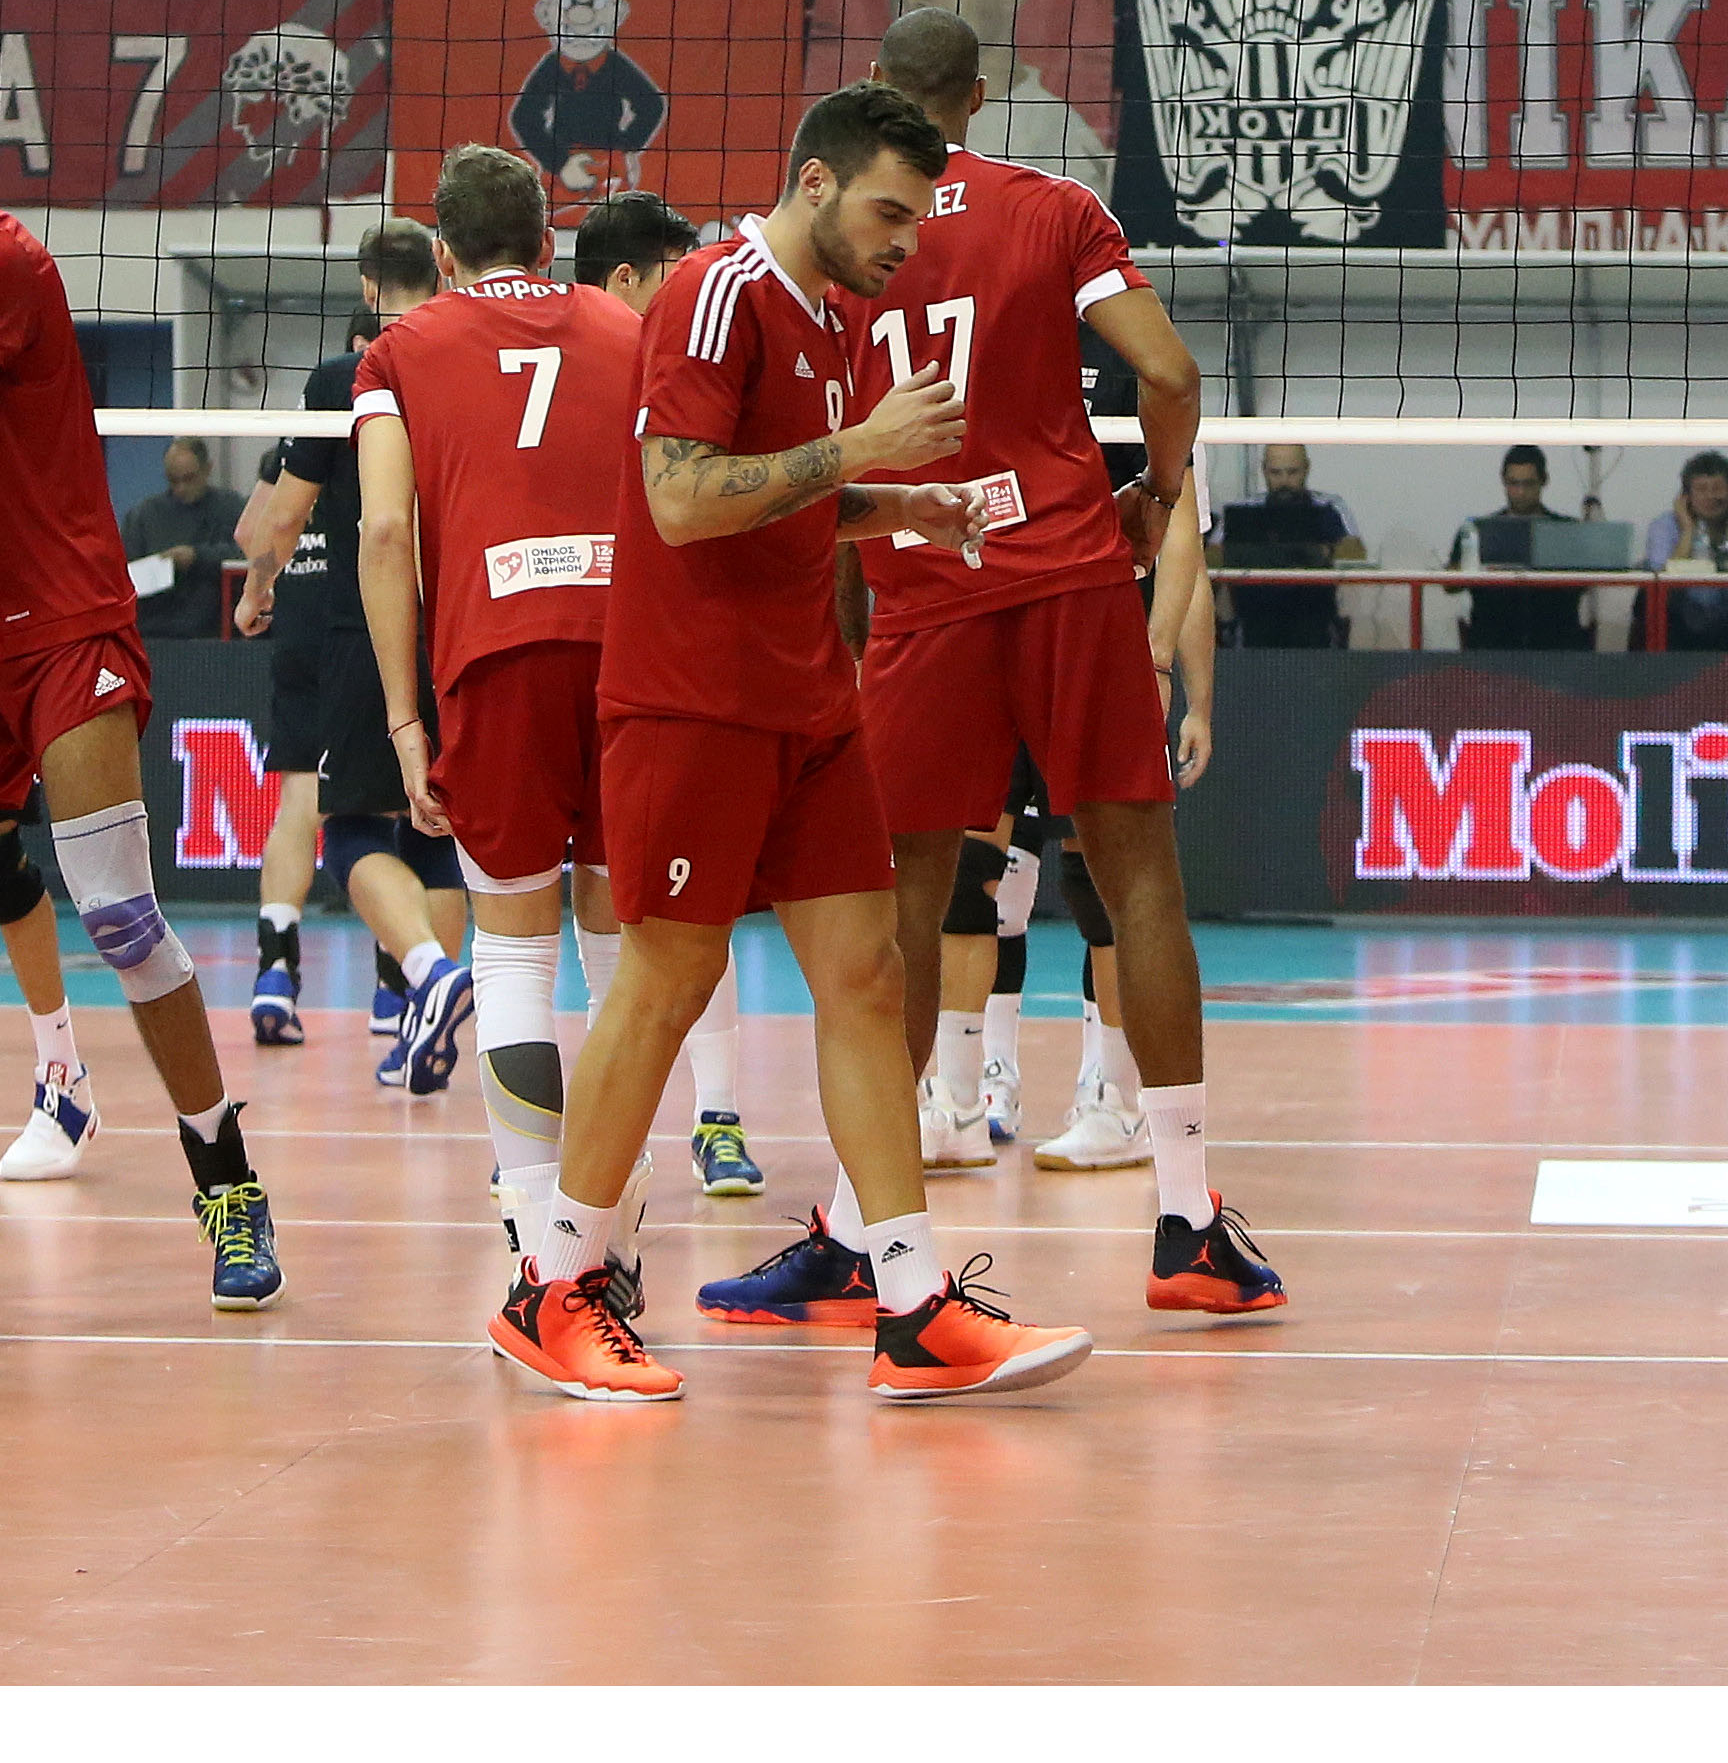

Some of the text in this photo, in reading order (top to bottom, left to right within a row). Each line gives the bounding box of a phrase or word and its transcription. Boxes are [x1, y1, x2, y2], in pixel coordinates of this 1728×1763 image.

[110, 35, 189, 178] 7
[927, 181, 969, 218] EZ
[453, 279, 569, 300] LIPPOV
[871, 296, 975, 408] 17
[498, 346, 562, 449] 7
[531, 546, 576, 557] ΟΜΙΛΟΣ
[533, 555, 582, 566] ΙΑΤΡΙΚΟΥ
[534, 564, 583, 576] ΑΘΗΝΩΝ
[667, 857, 691, 899] 9
